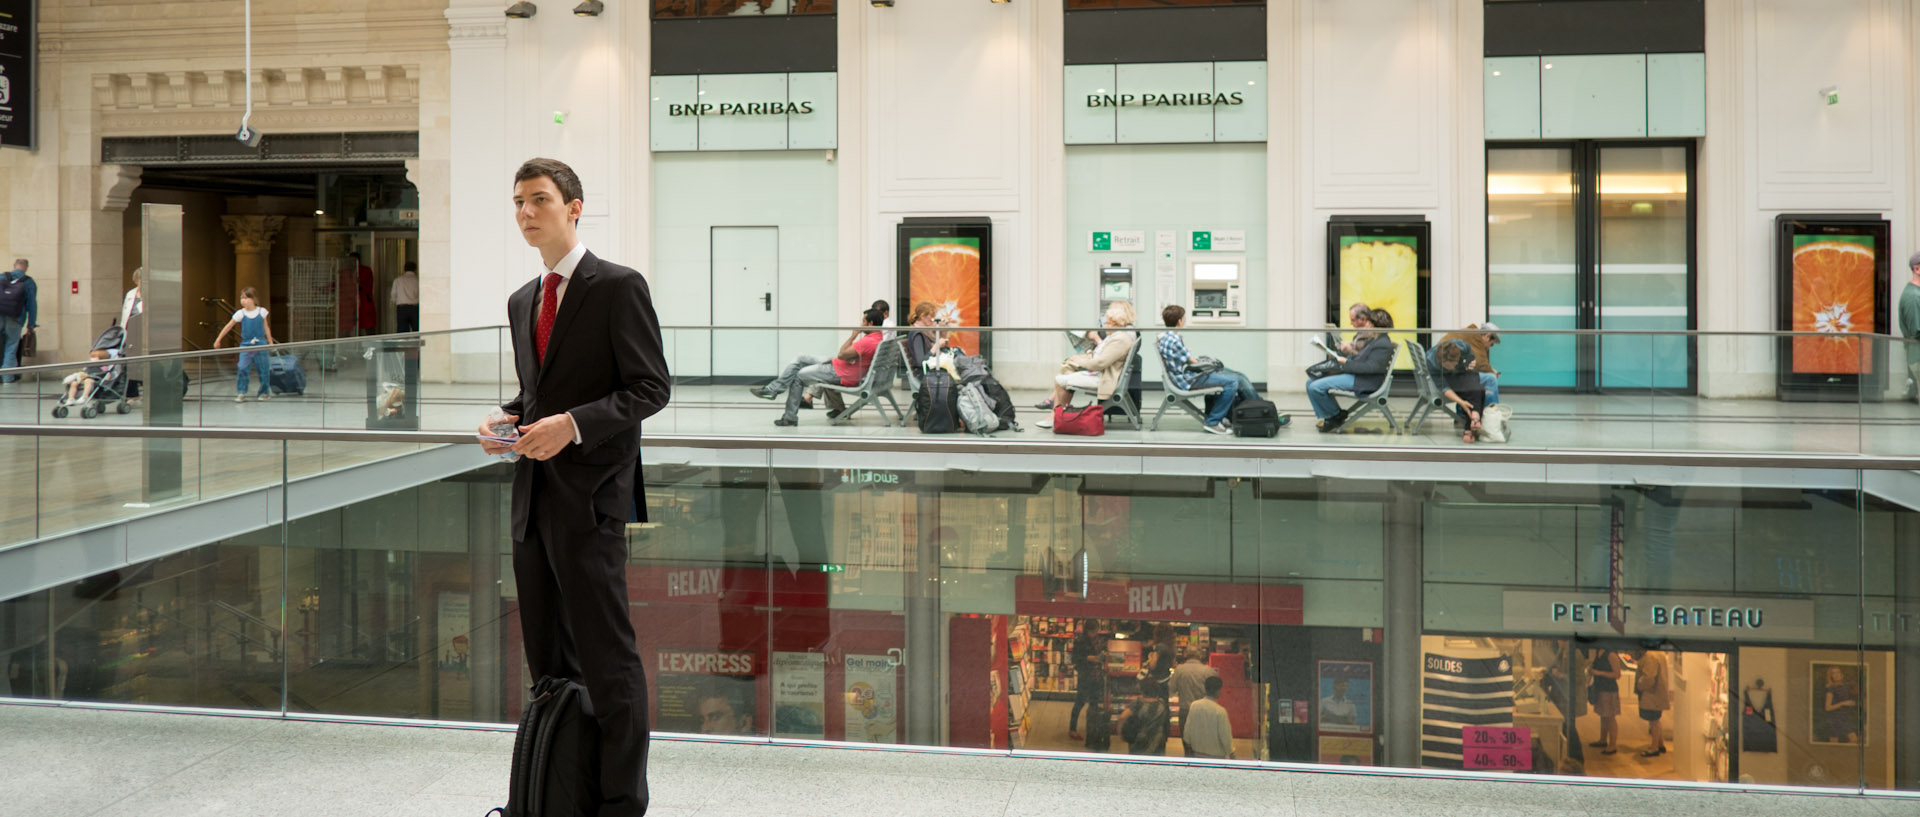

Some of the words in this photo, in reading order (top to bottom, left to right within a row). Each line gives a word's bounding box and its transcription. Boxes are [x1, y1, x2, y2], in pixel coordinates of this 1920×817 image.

[1087, 94, 1134, 107] BNP
[1142, 91, 1243, 106] PARIBAS
[669, 103, 713, 116] BNP
[720, 101, 813, 115] PARIBAS
[1653, 606, 1763, 628] BATEAU
[658, 652, 752, 673] L'EXPRESS
[1427, 657, 1463, 674] SOLDES
